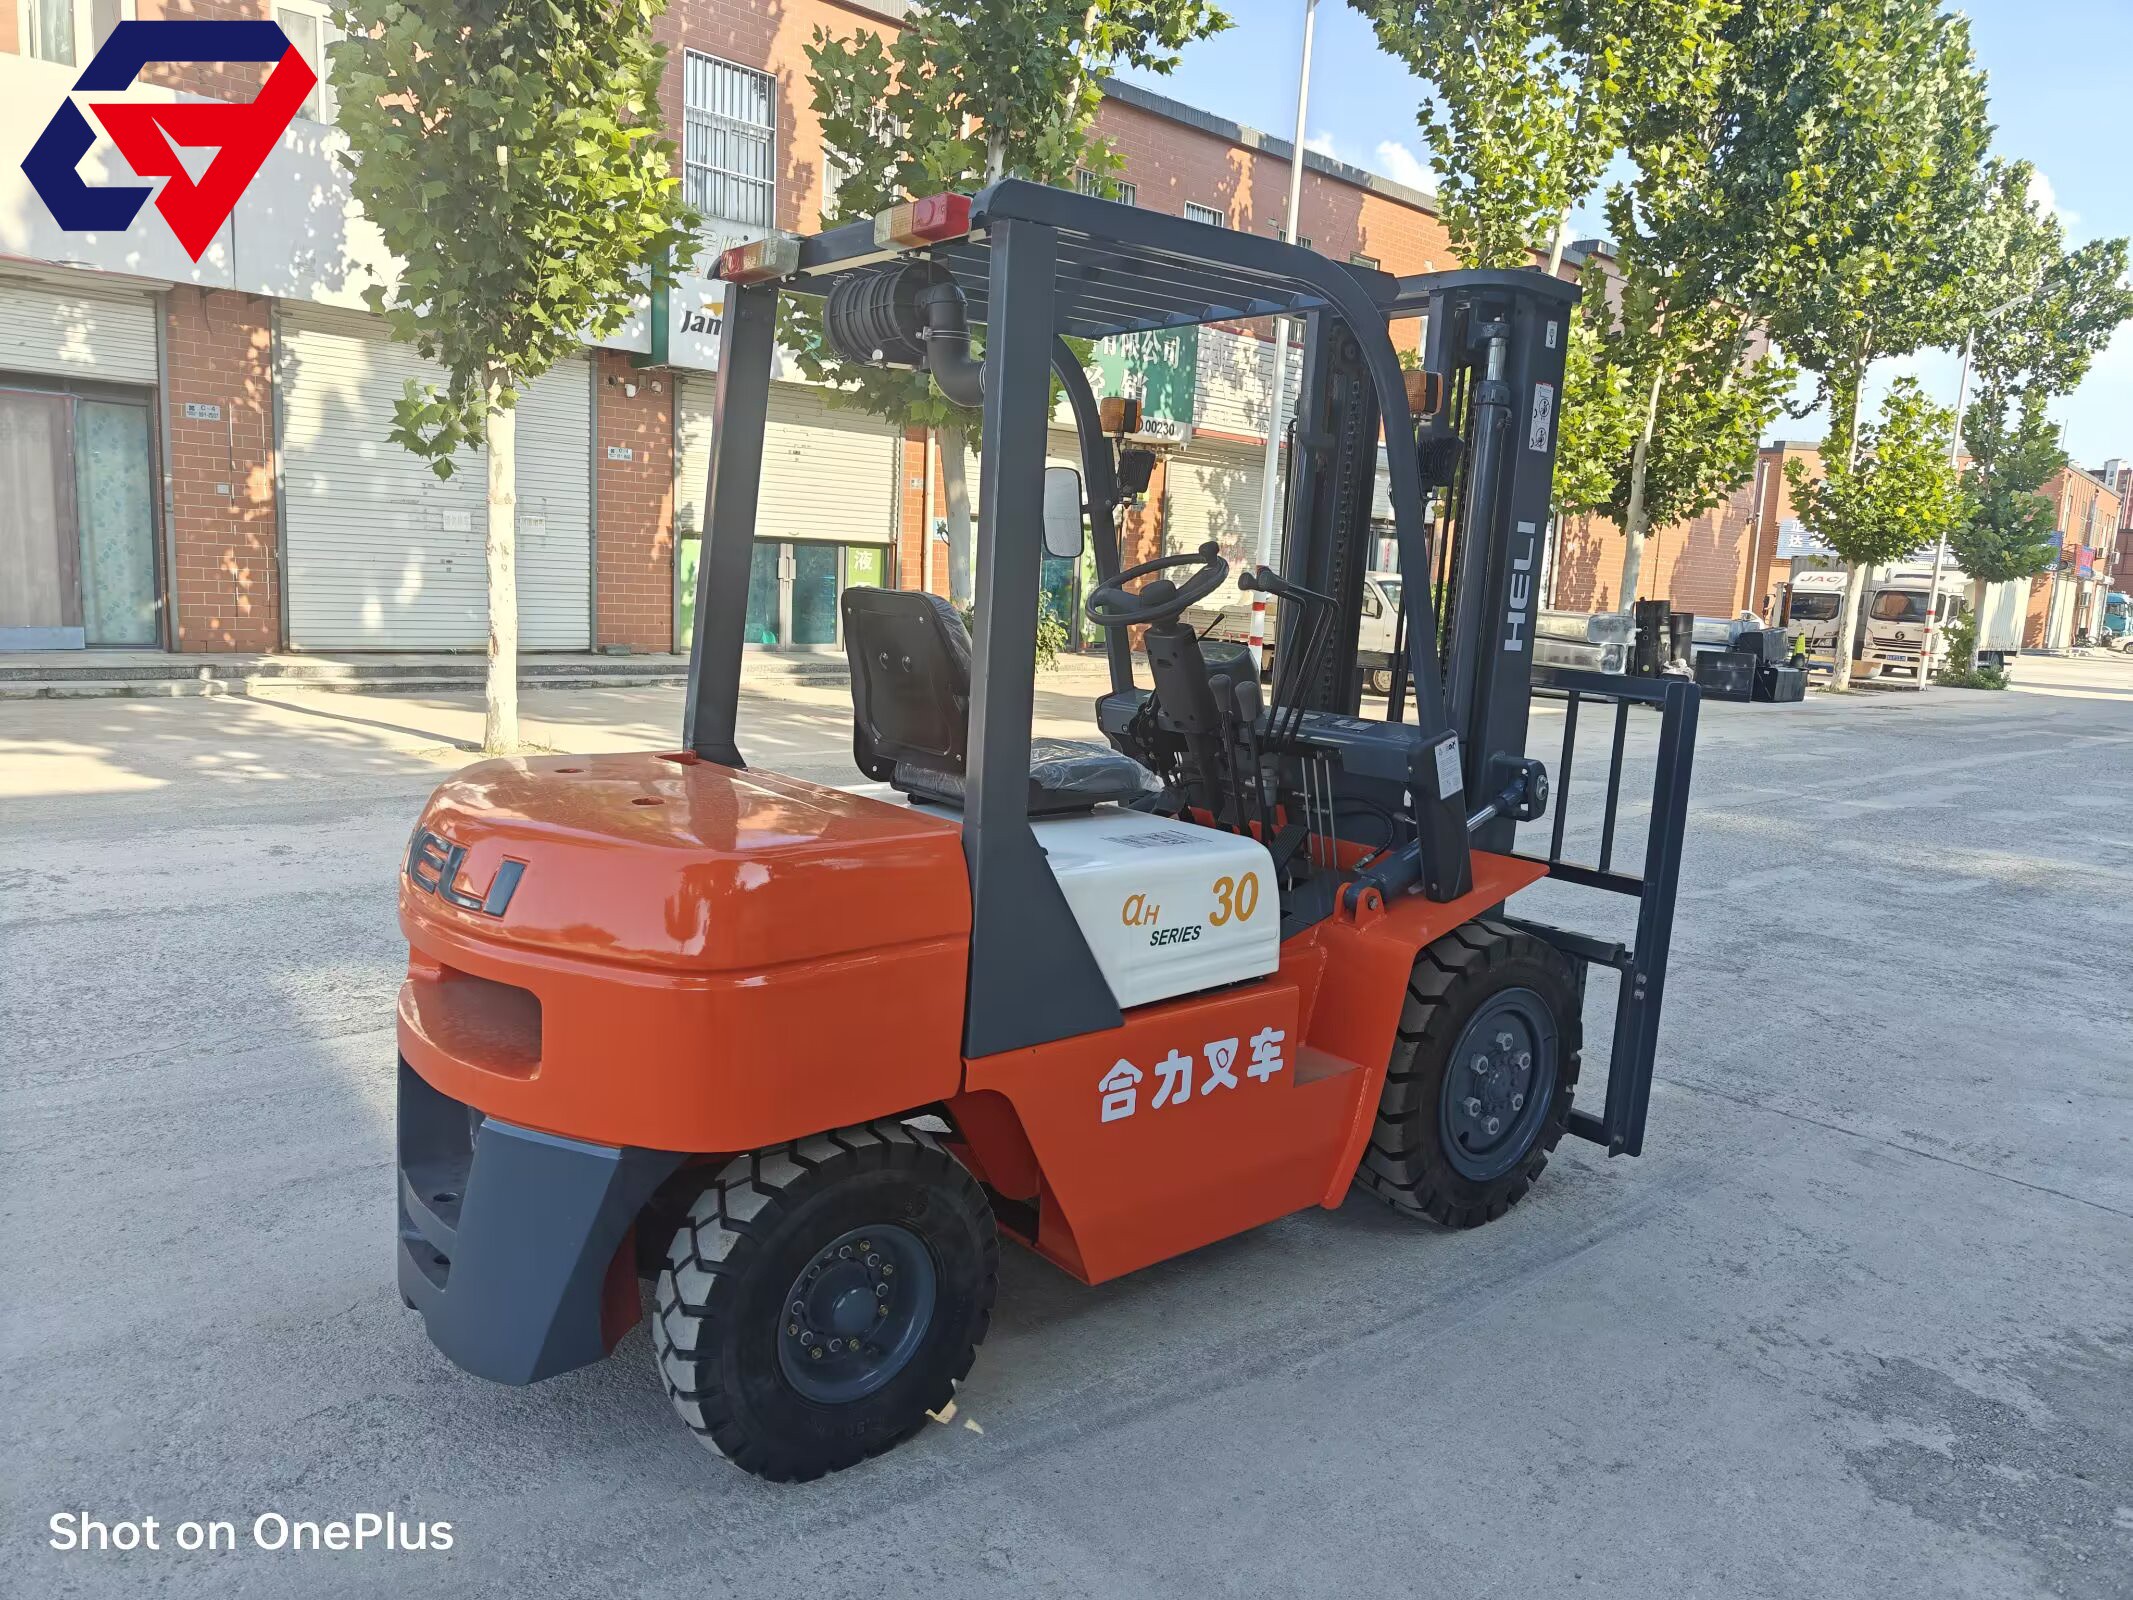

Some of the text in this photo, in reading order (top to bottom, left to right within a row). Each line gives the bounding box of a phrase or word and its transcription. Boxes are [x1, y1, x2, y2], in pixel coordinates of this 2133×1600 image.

[1504, 521, 1535, 651] HELI
[405, 827, 527, 918] ELI
[1209, 872, 1259, 926] 30
[1149, 925, 1202, 946] SERIES
[1099, 1027, 1285, 1123] 合力叉车
